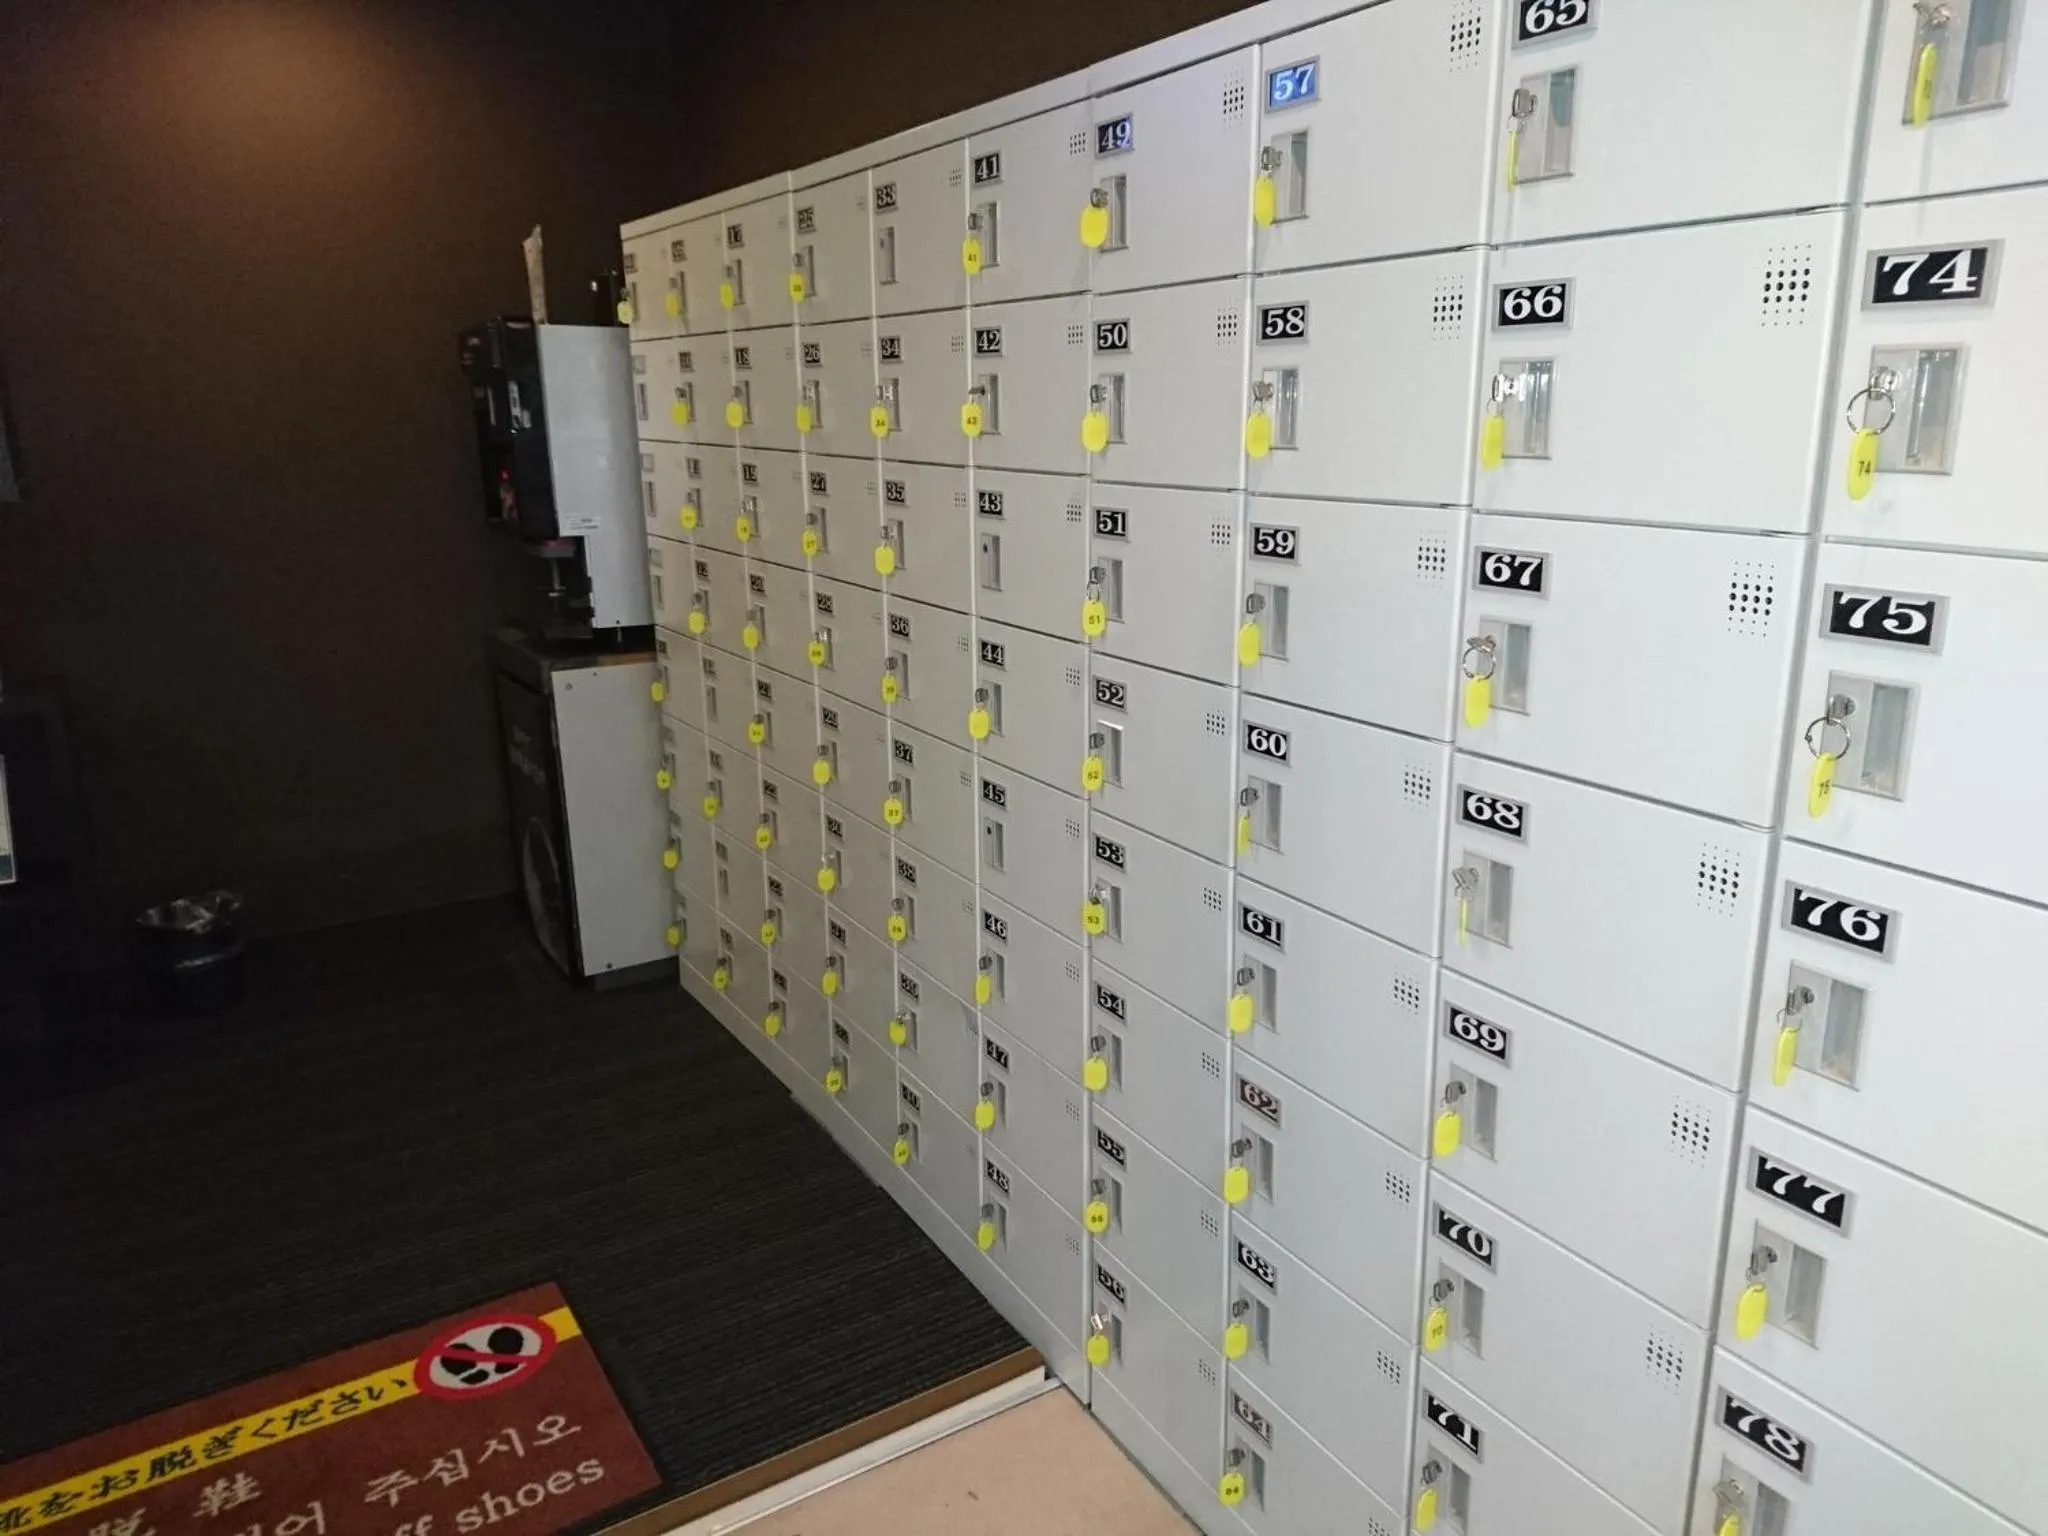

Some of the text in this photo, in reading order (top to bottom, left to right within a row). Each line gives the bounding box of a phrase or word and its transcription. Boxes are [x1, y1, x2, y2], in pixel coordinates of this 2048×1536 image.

[1524, 0, 1587, 34] 65
[1273, 64, 1315, 101] 57
[1101, 121, 1131, 152] 49
[976, 154, 999, 179] 41
[967, 253, 977, 263] 41
[1882, 250, 1977, 295] 74
[1503, 284, 1563, 320] 66
[1099, 323, 1127, 347] 50
[1264, 307, 1305, 336] 58
[881, 337, 900, 356] 34
[978, 331, 1001, 351] 42
[1857, 459, 1871, 478] 74
[886, 481, 904, 500] 35
[979, 493, 1002, 514] 43
[1099, 511, 1126, 534] 51
[1256, 528, 1295, 554] 59
[1484, 555, 1542, 587] 67
[891, 615, 909, 635] 36
[1088, 614, 1100, 625] 51
[1839, 594, 1928, 636] 75
[981, 642, 1004, 664] 44
[1098, 682, 1124, 705] 52
[894, 741, 913, 761] 37
[1250, 728, 1287, 756] 60
[983, 780, 1005, 804] 45
[1817, 779, 1830, 798] 75
[1466, 795, 1520, 829] 68
[1097, 836, 1124, 865] 53
[984, 912, 1007, 939] 46
[1247, 911, 1281, 943] 61
[1798, 891, 1882, 942] 76
[1099, 988, 1125, 1018] 54
[1453, 1012, 1505, 1052] 69
[987, 1039, 1009, 1067] 47
[1243, 1082, 1278, 1116] 62
[1098, 1130, 1125, 1161] 55
[987, 1160, 1009, 1191] 48
[1764, 1161, 1844, 1214] 77
[1444, 1213, 1492, 1257] 70
[1241, 1246, 1275, 1284] 63
[1098, 1267, 1125, 1300] 56
[1238, 1400, 1271, 1438] 64
[1432, 1401, 1479, 1452] 71
[1729, 1401, 1801, 1461] 78
[364, 1415, 582, 1507] 주십시오
[193, 1471, 263, 1518] 鞋
[455, 1456, 605, 1534] shoes
